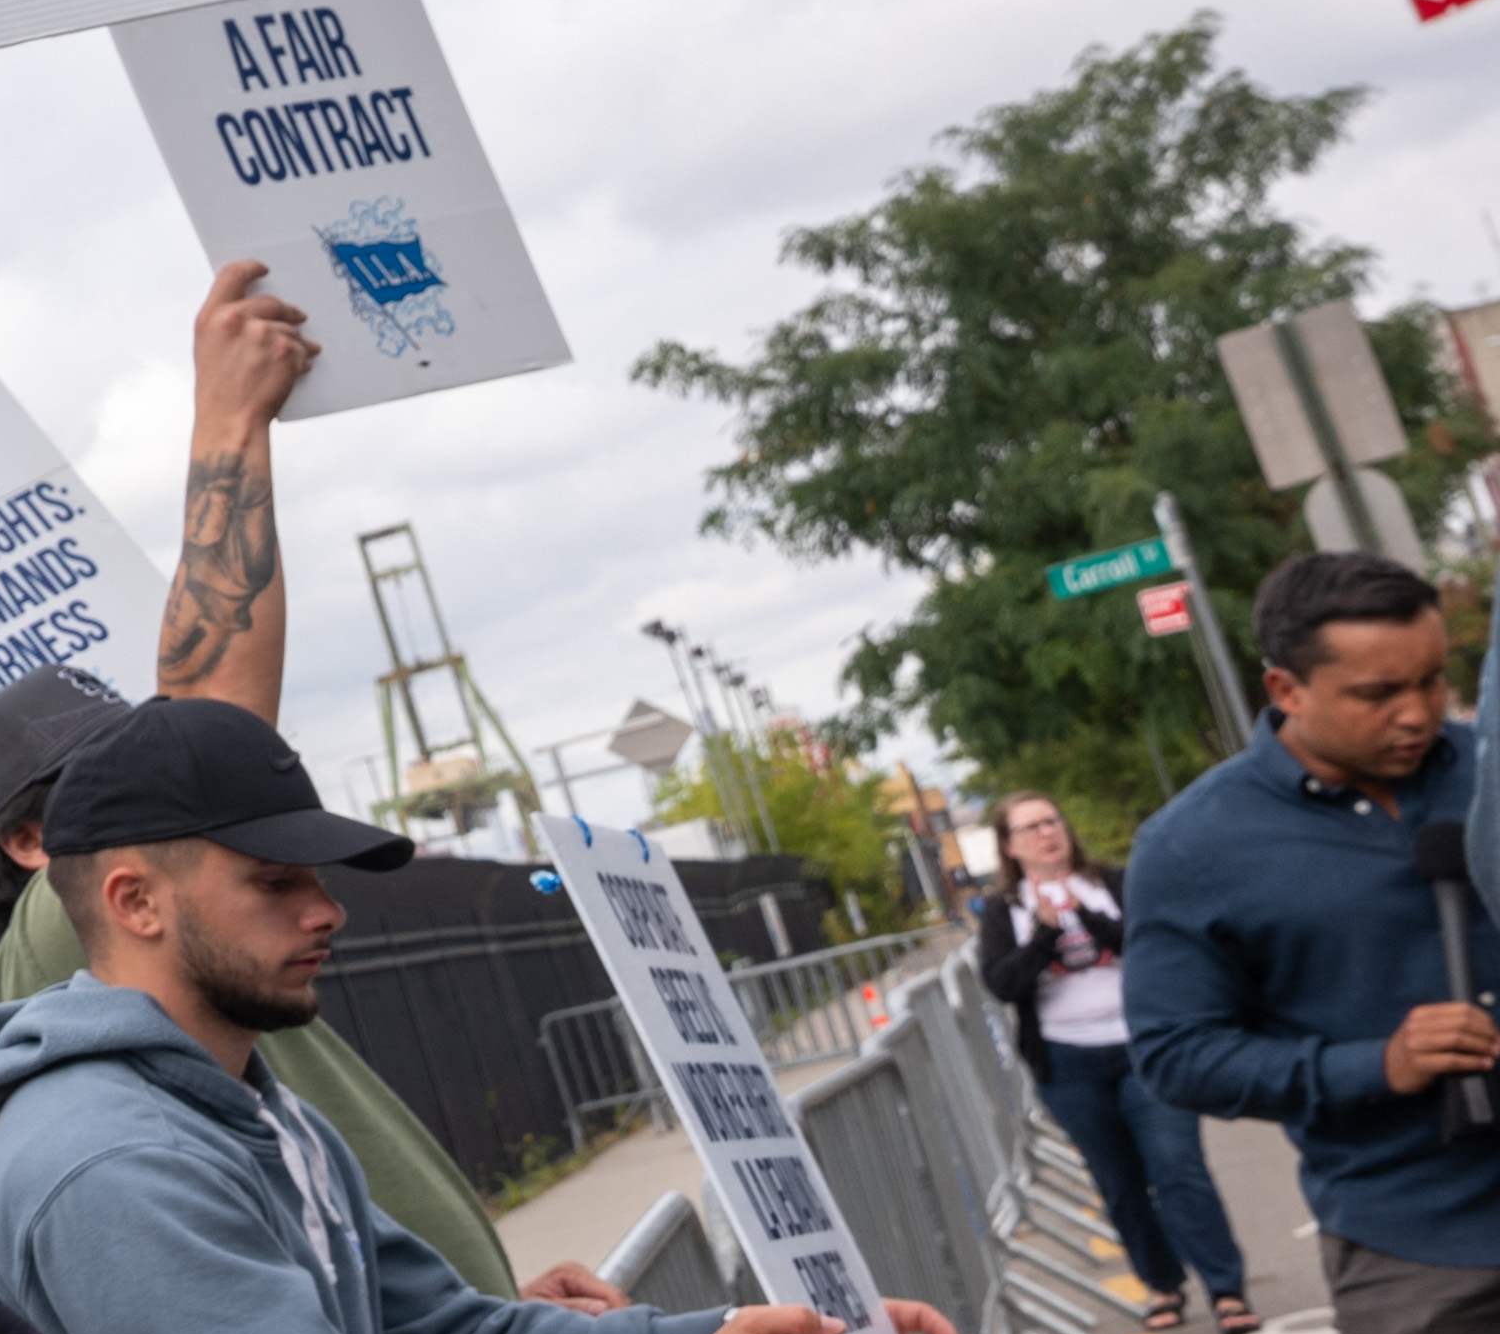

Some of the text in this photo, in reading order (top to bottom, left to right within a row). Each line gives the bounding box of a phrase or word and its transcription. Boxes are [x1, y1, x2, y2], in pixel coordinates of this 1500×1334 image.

[223, 7, 362, 92] A FAIR
[216, 87, 432, 186] CONTRACT
[1062, 549, 1140, 594] Carroll
